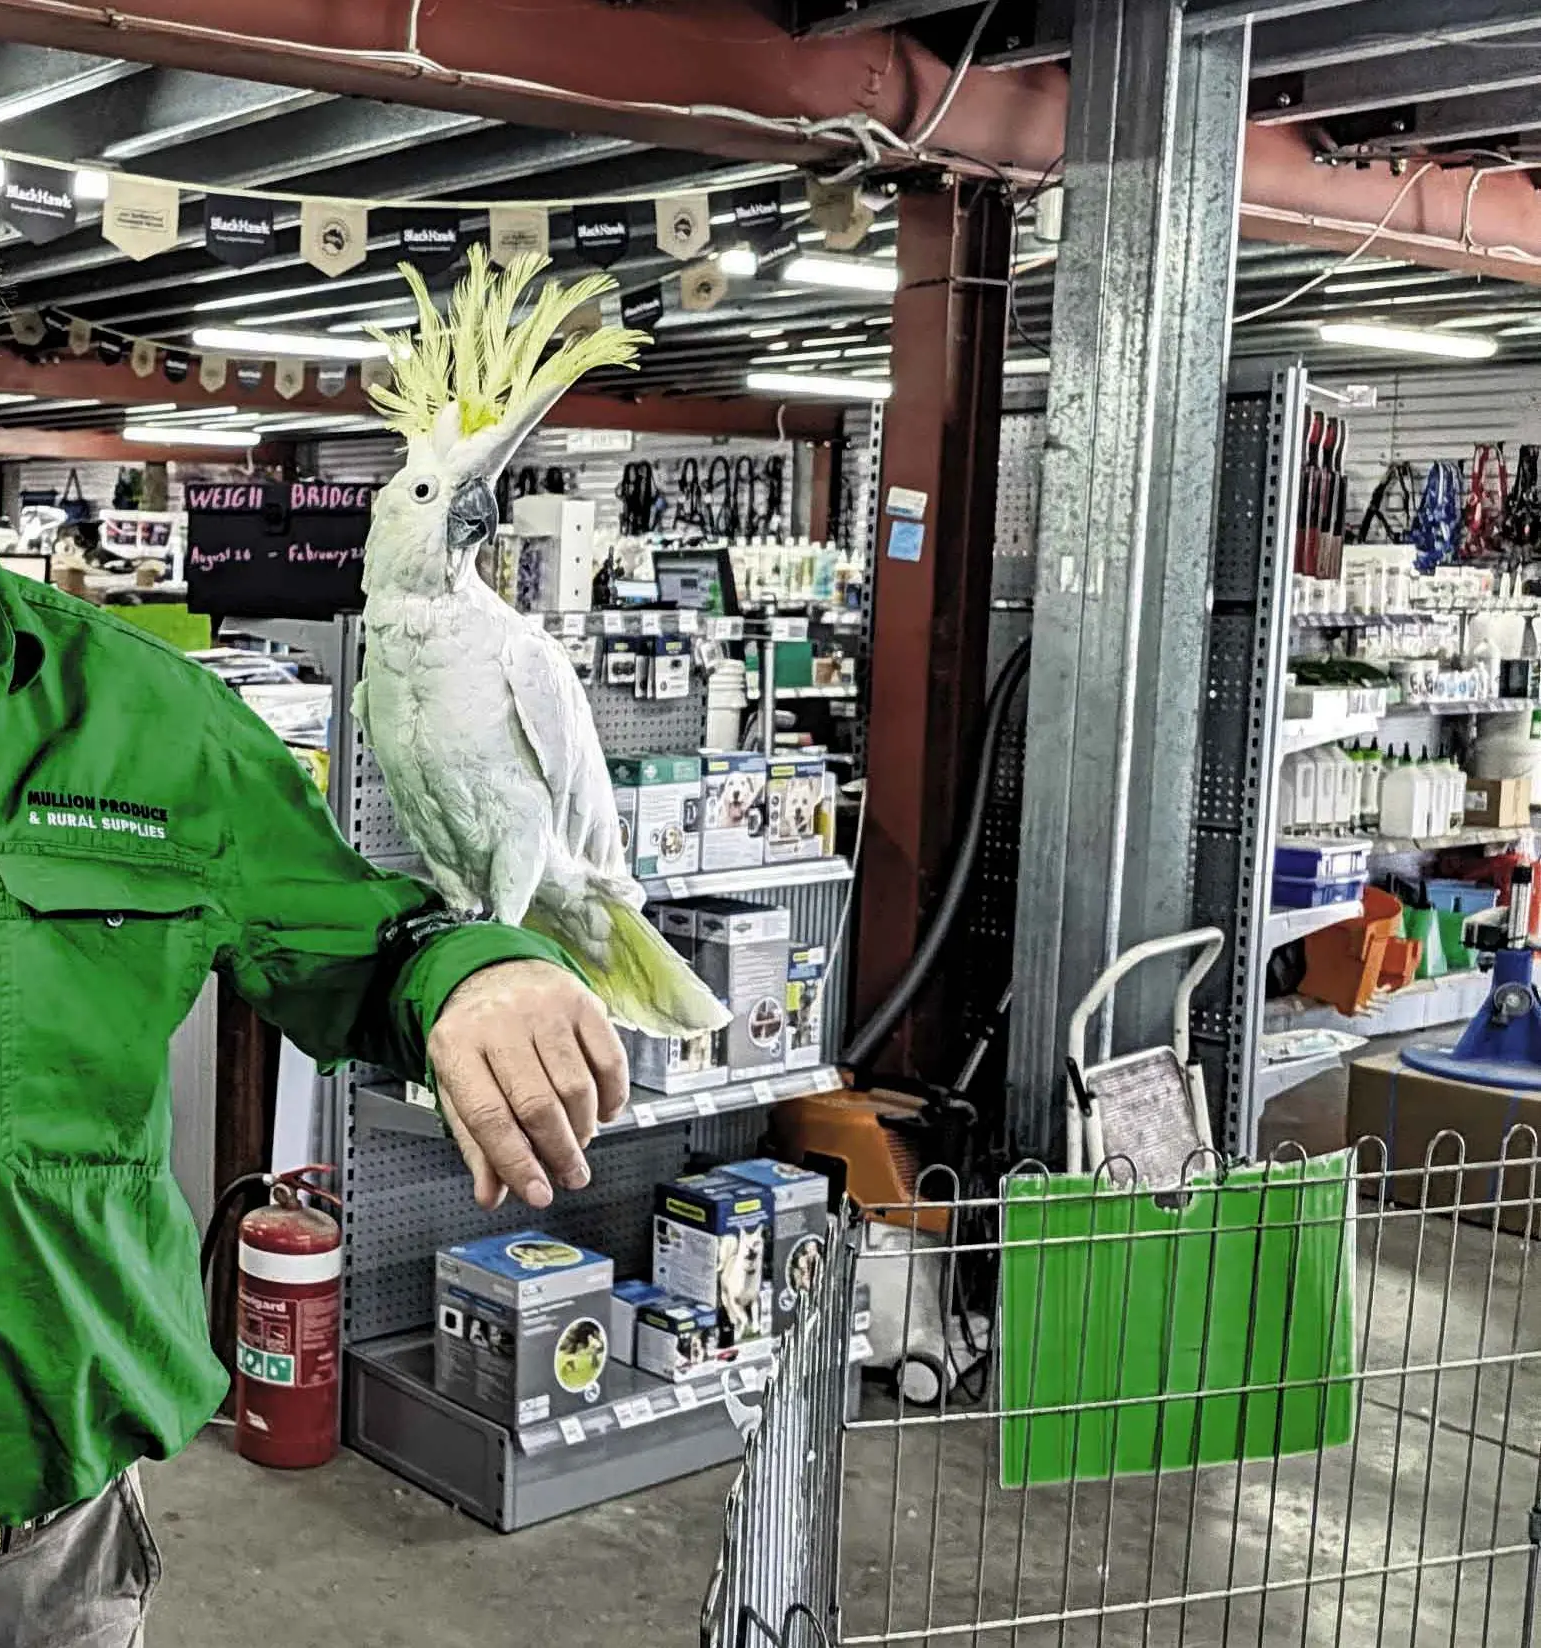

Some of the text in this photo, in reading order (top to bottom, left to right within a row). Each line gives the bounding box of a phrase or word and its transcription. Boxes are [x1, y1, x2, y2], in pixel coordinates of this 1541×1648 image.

[6, 185, 72, 209] BlackHawk
[210, 216, 270, 235] BlackHawk
[404, 229, 456, 242] BlackHawk
[190, 484, 369, 509] WEIGH BRIDGE
[191, 547, 231, 572] August
[289, 542, 347, 567] February
[28, 791, 168, 822] MULLION PRODUCE
[29, 811, 166, 839] & RURAL SUPPLIES
